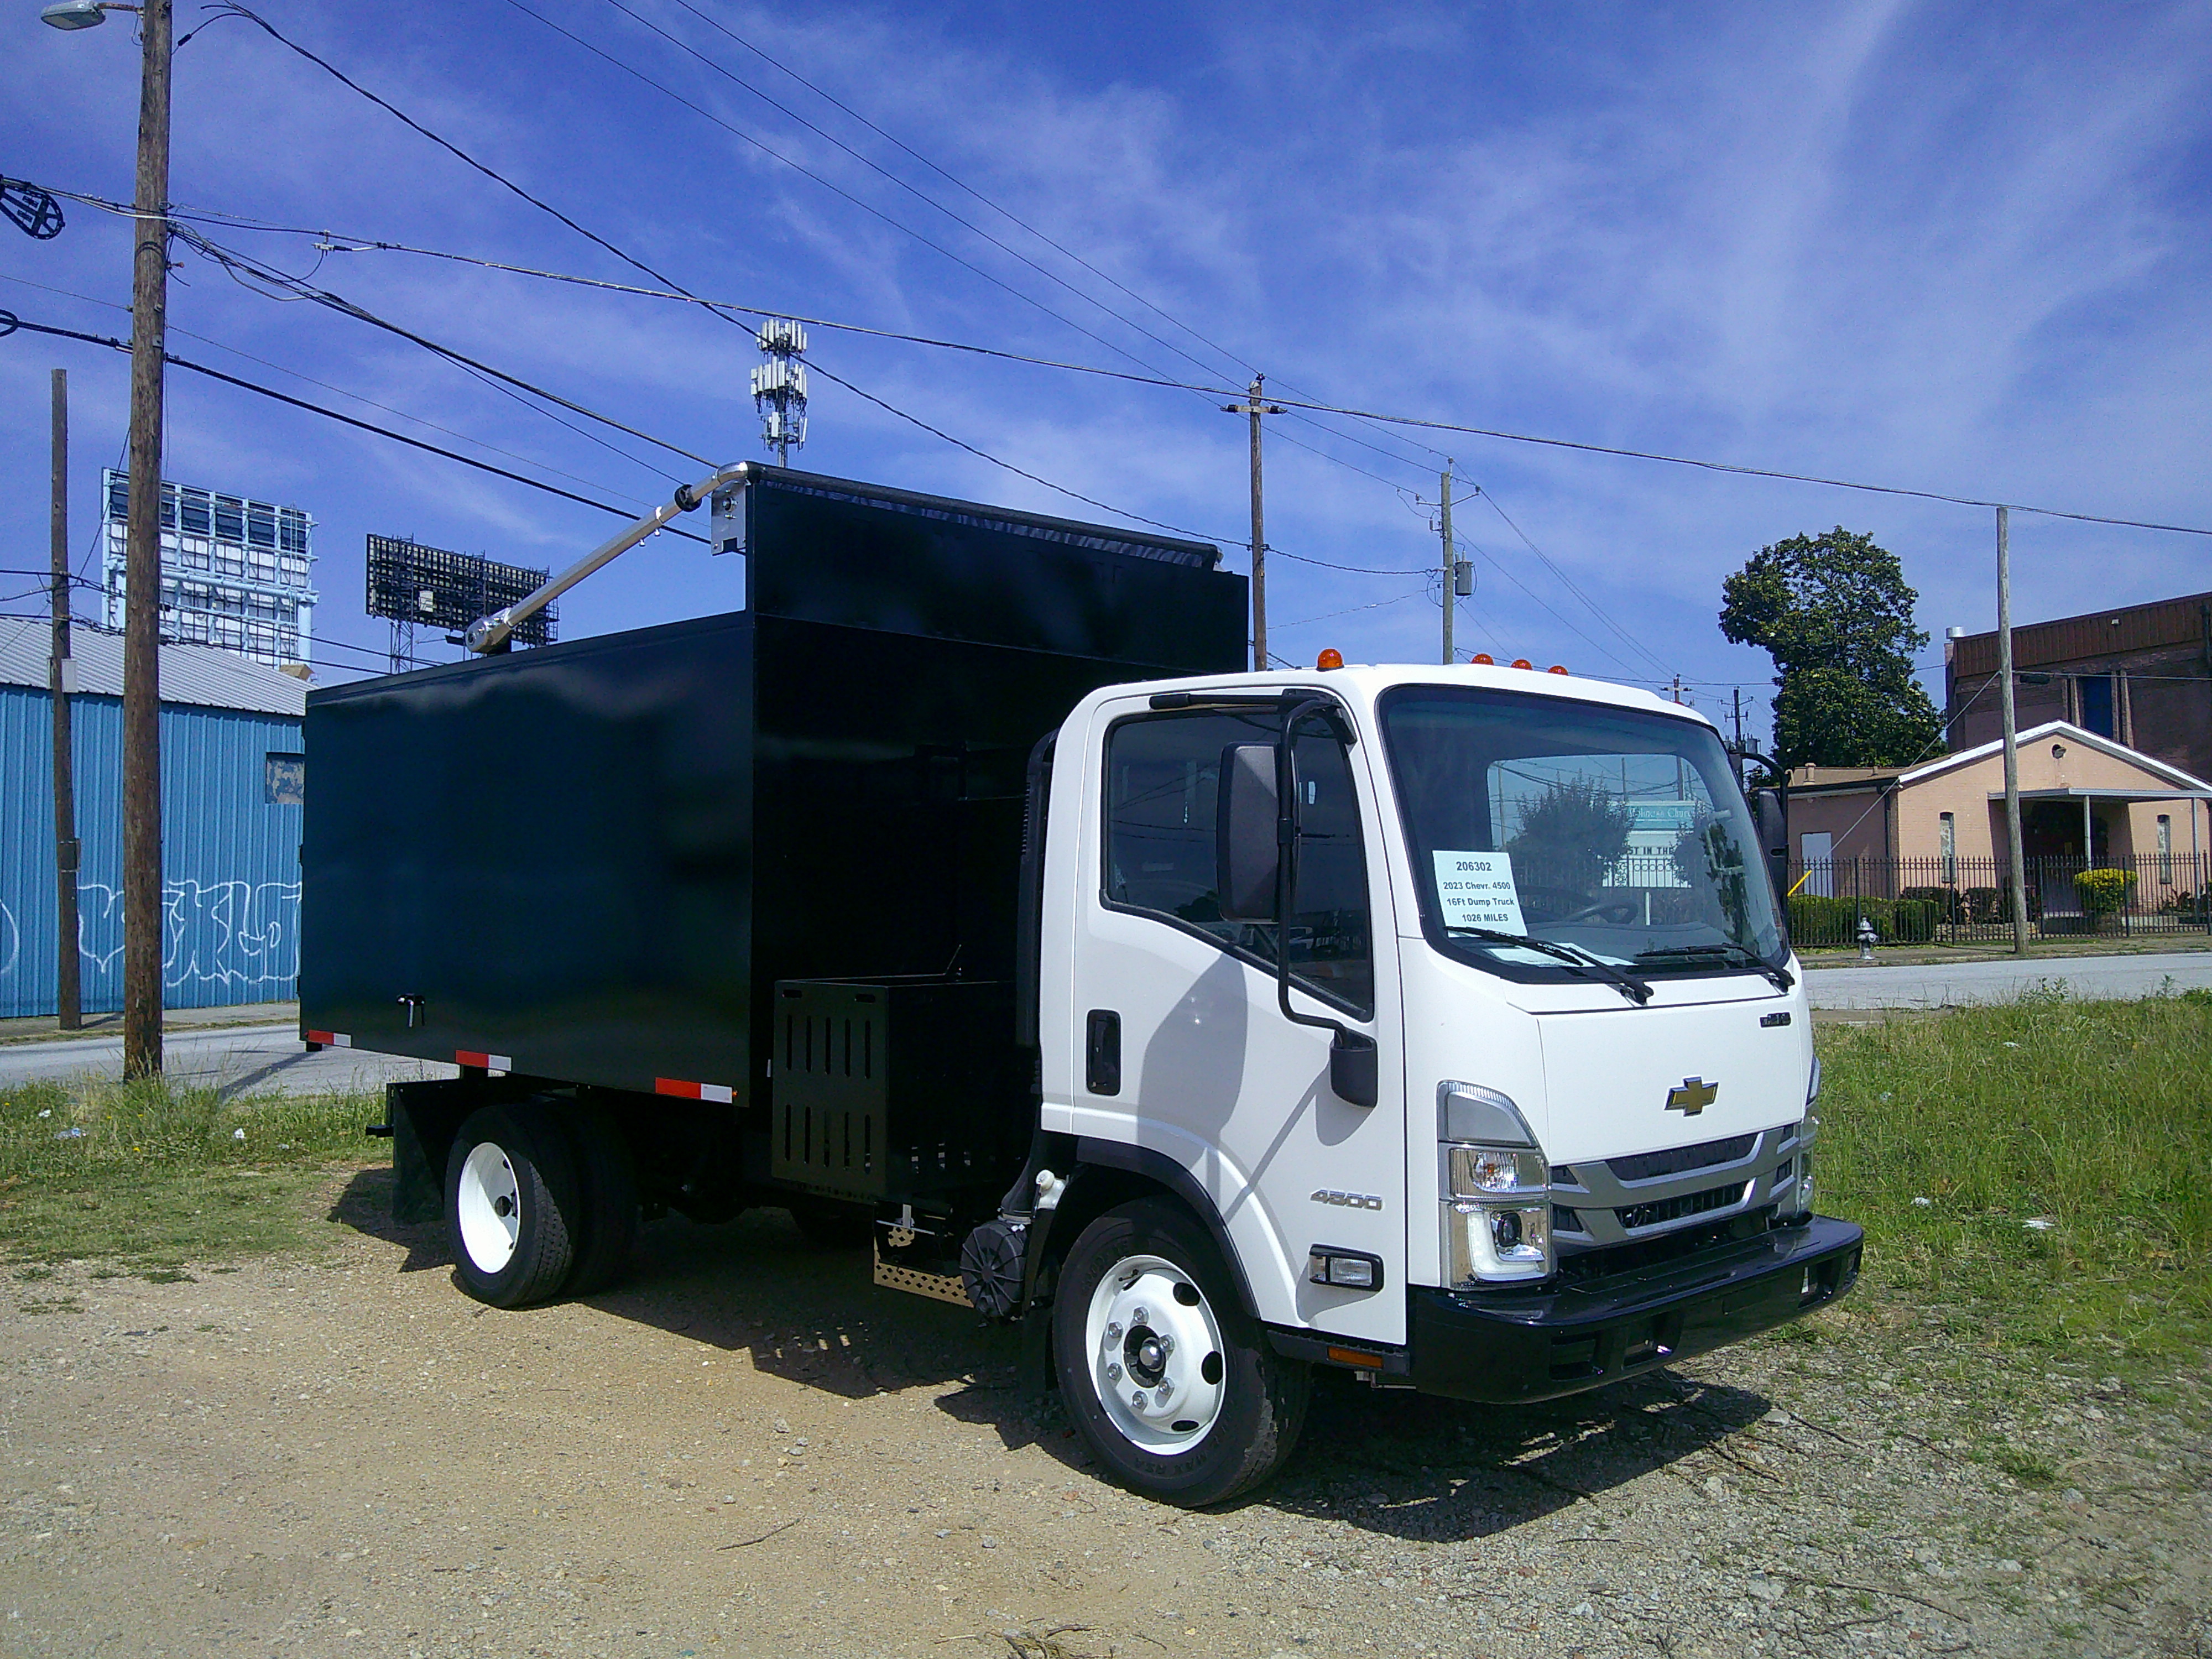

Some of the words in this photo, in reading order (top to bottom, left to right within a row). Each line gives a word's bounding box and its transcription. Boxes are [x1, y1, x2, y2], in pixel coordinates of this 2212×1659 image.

[1667, 807, 1693, 818] Churc
[1643, 847, 1652, 855] IN
[1456, 862, 1492, 871] 206302
[1447, 898, 1466, 906] 16Ft
[1468, 898, 1491, 907] Dump
[1492, 898, 1515, 906] Truck
[1462, 914, 1481, 922] 1026
[1484, 914, 1508, 922] MILES
[1310, 1190, 1383, 1211] 4500
